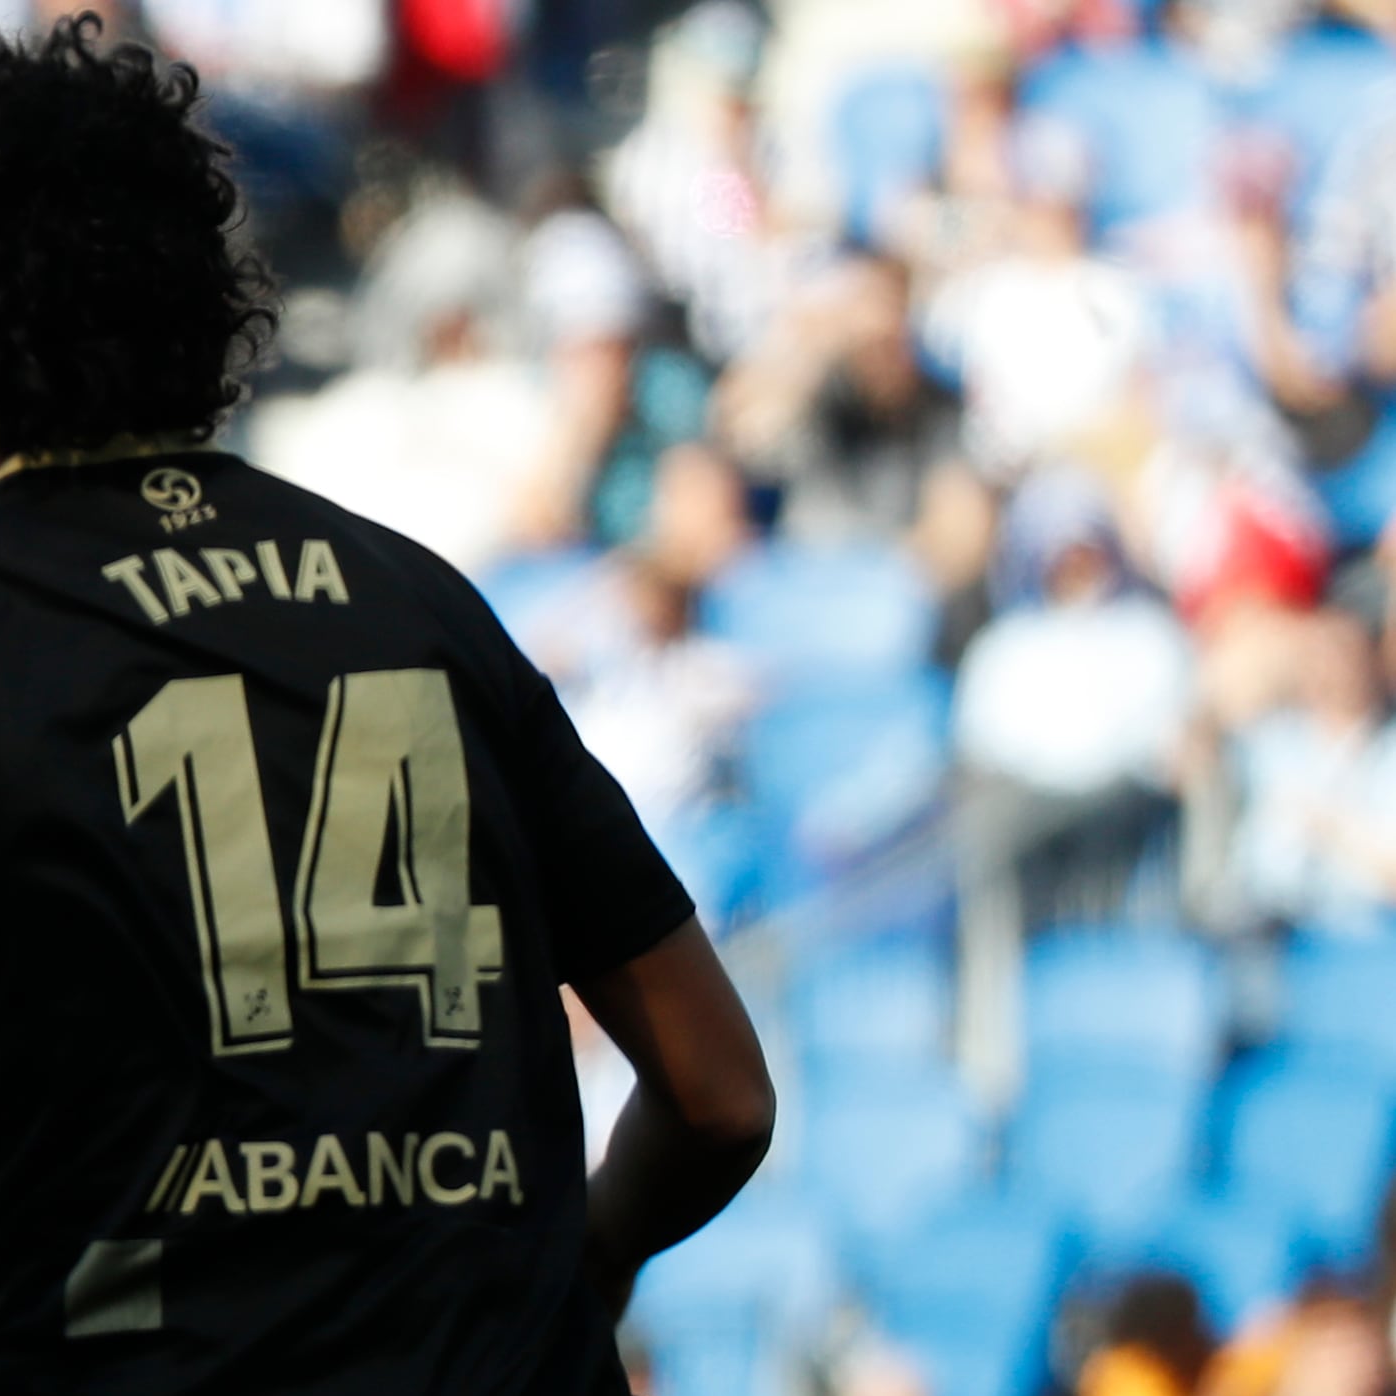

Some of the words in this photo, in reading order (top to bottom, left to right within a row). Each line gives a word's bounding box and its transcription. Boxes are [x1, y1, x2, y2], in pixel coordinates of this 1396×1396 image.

[160, 503, 217, 534] 1923
[101, 538, 350, 626] TAPIA
[112, 667, 503, 1057] 14
